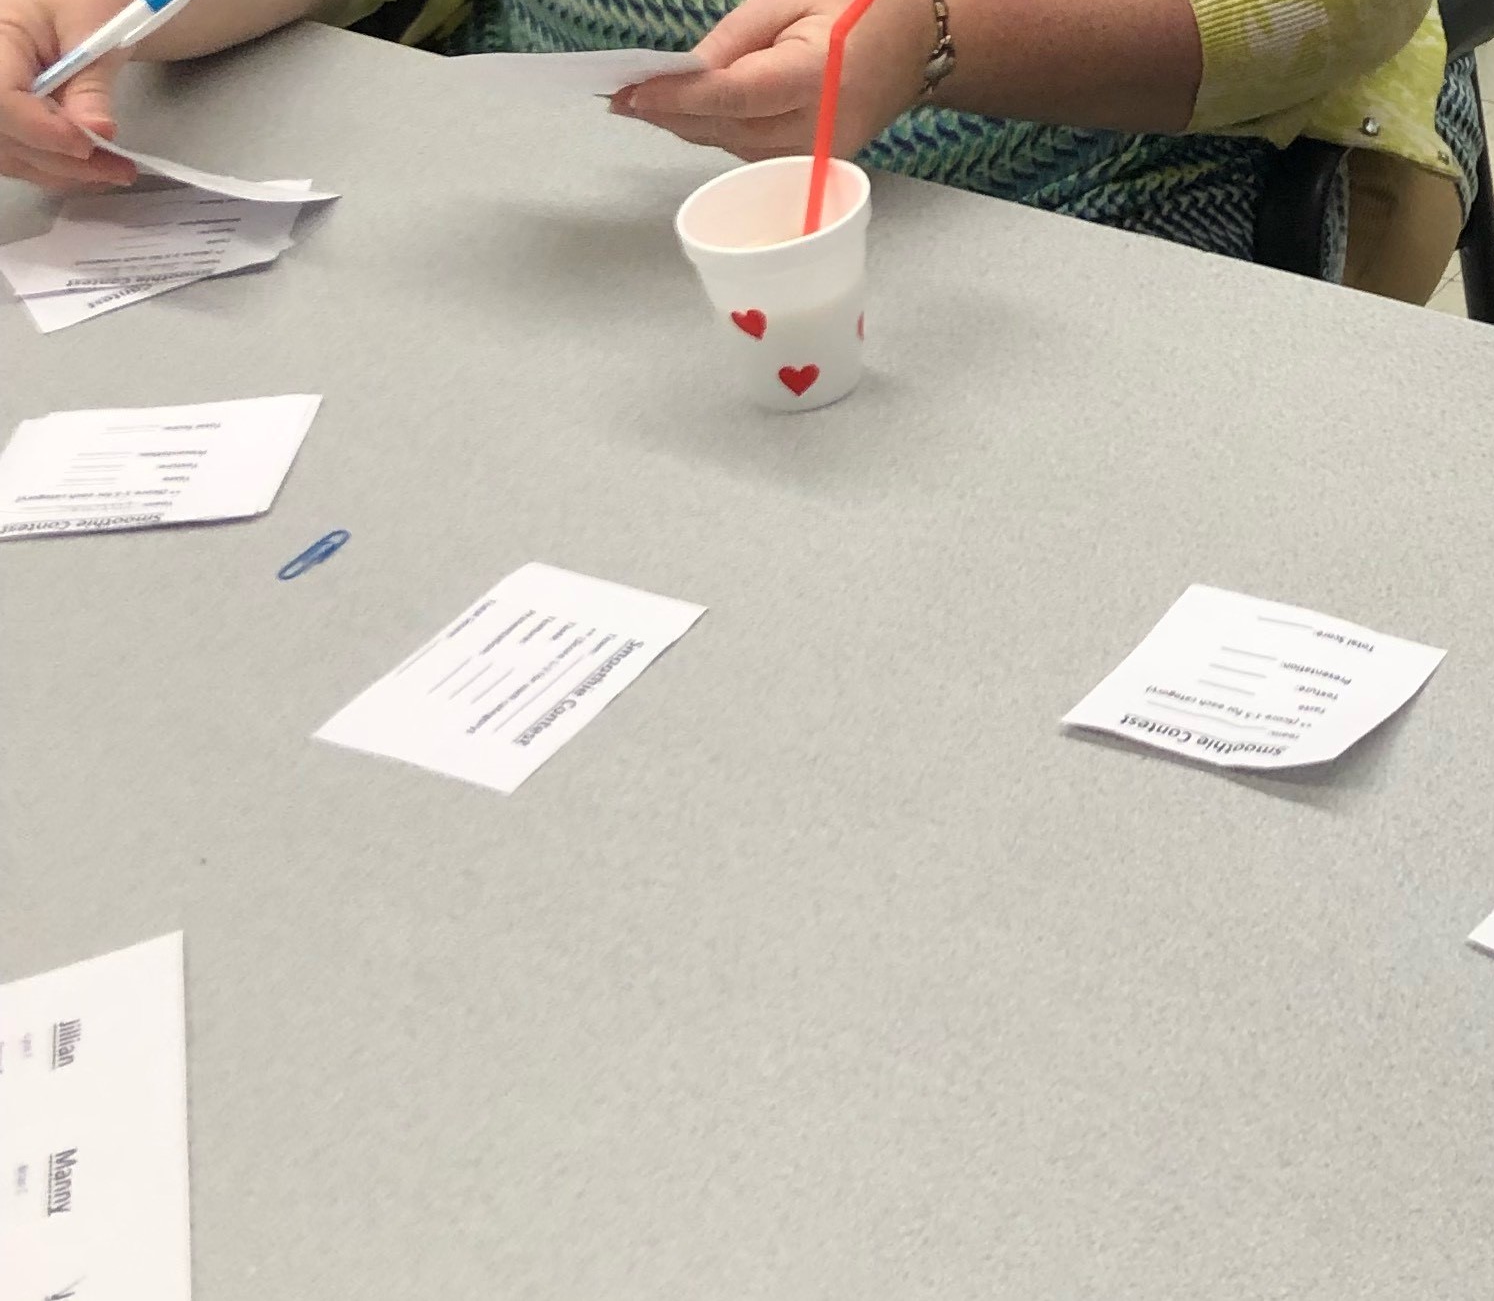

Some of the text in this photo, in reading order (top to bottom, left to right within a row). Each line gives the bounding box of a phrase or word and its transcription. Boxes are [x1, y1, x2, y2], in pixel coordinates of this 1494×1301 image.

[572, 638, 644, 698] Smoothie
[514, 696, 578, 746] Contest
[1118, 713, 1286, 756] Smoothie Contest
[56, 1018, 82, 1068] Jillian
[48, 1148, 78, 1216] Manny
